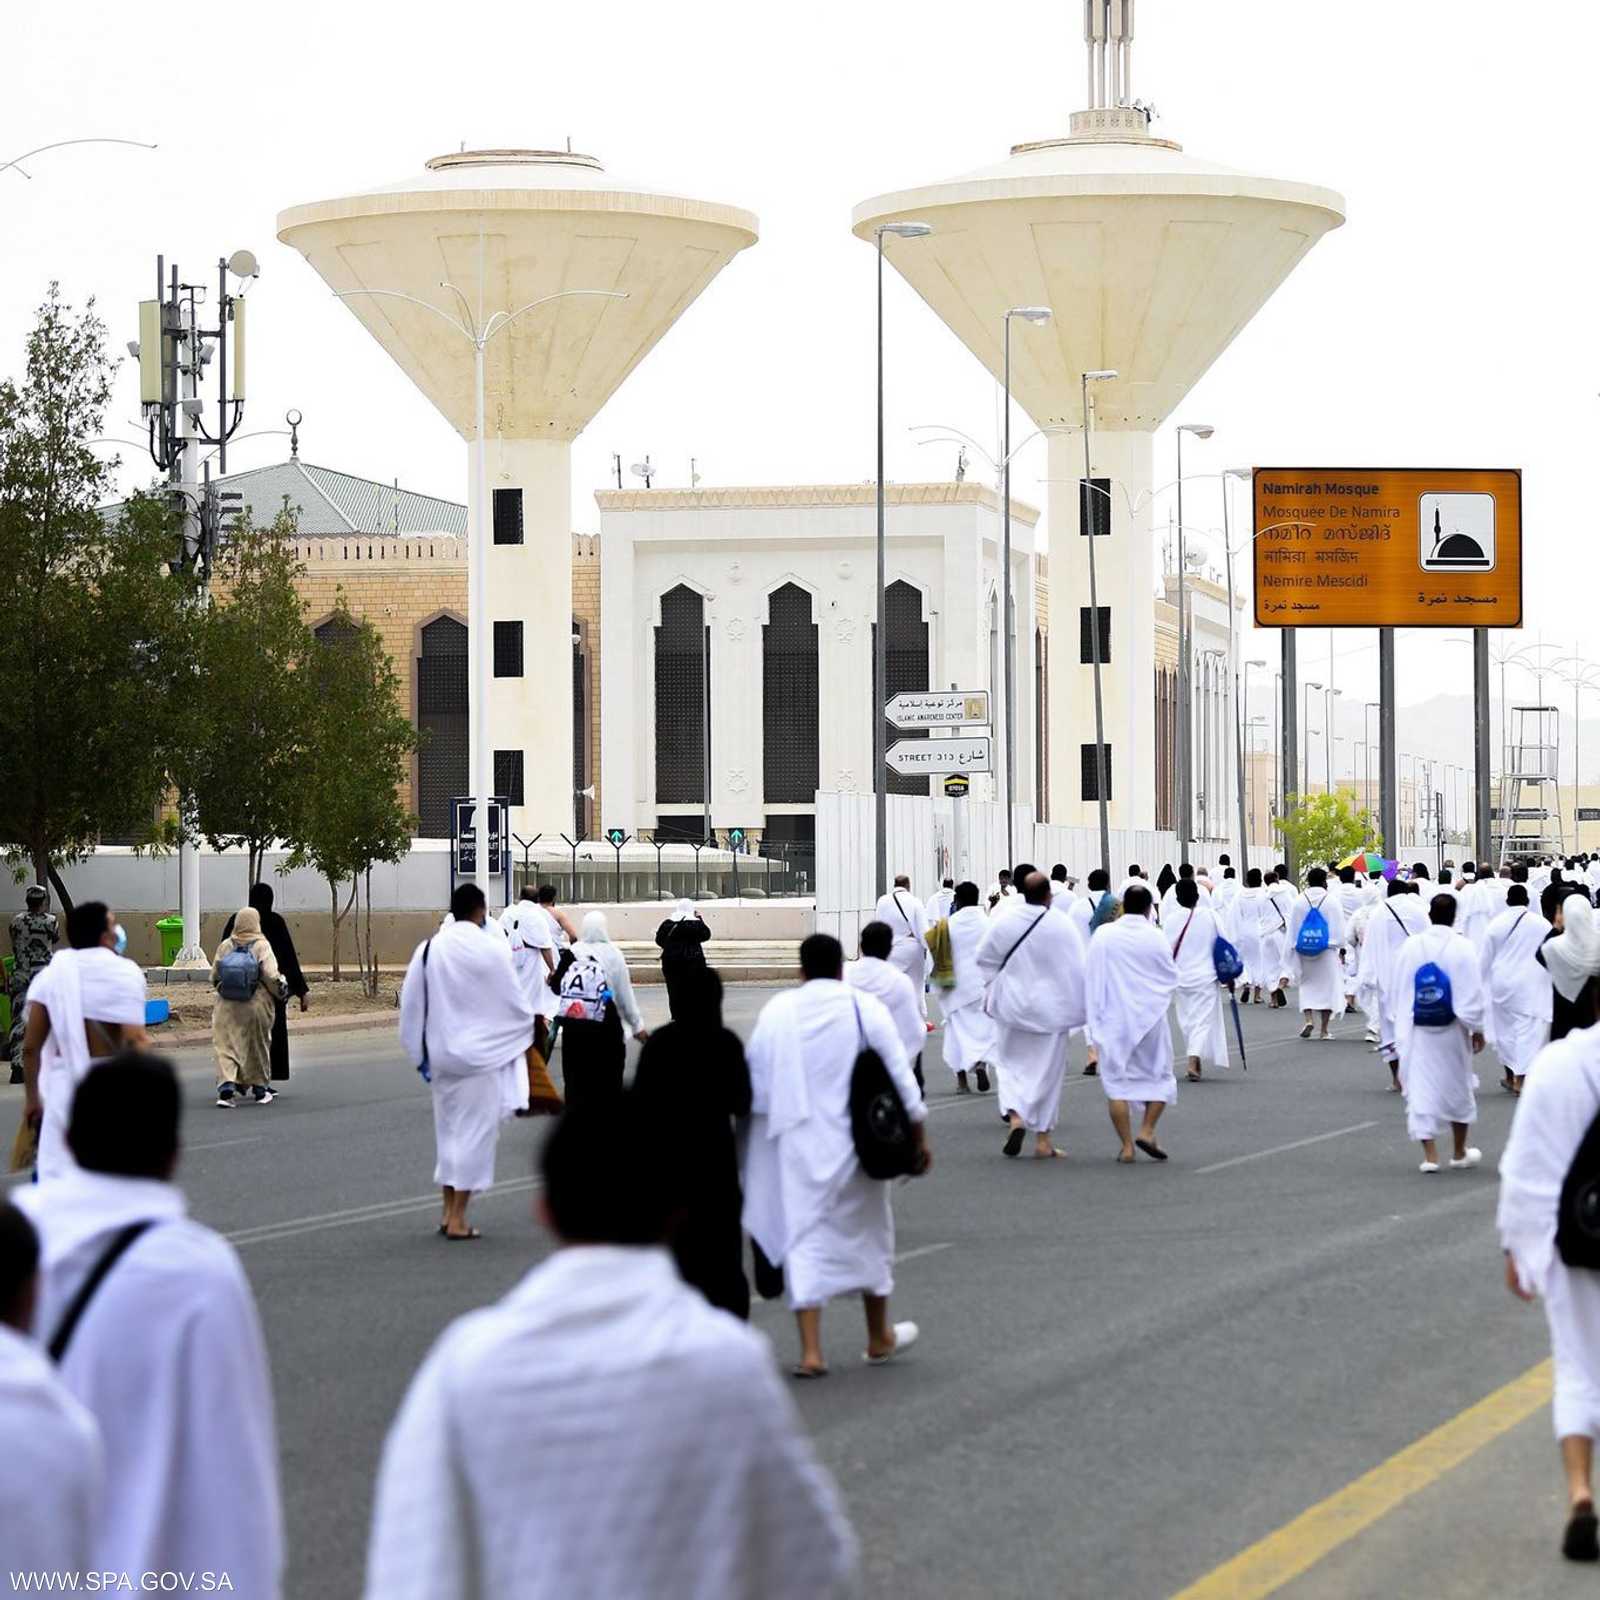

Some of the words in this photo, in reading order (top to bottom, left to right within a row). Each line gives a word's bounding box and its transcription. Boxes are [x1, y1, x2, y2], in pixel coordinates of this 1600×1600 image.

[1263, 483, 1321, 495] Namirah
[1325, 483, 1379, 497] Mosque
[1329, 505, 1348, 518] De
[1352, 505, 1400, 518] Namira
[1263, 575, 1312, 587] Nemire
[1317, 573, 1368, 587] Mescidi
[1418, 592, 1447, 606] نمرة
[1454, 594, 1497, 606] مسجد
[1264, 600, 1287, 613] نمرة
[1291, 601, 1320, 613] مسجد
[898, 754, 932, 762] STREET
[937, 753, 954, 761] 313
[959, 750, 985, 765] شارع
